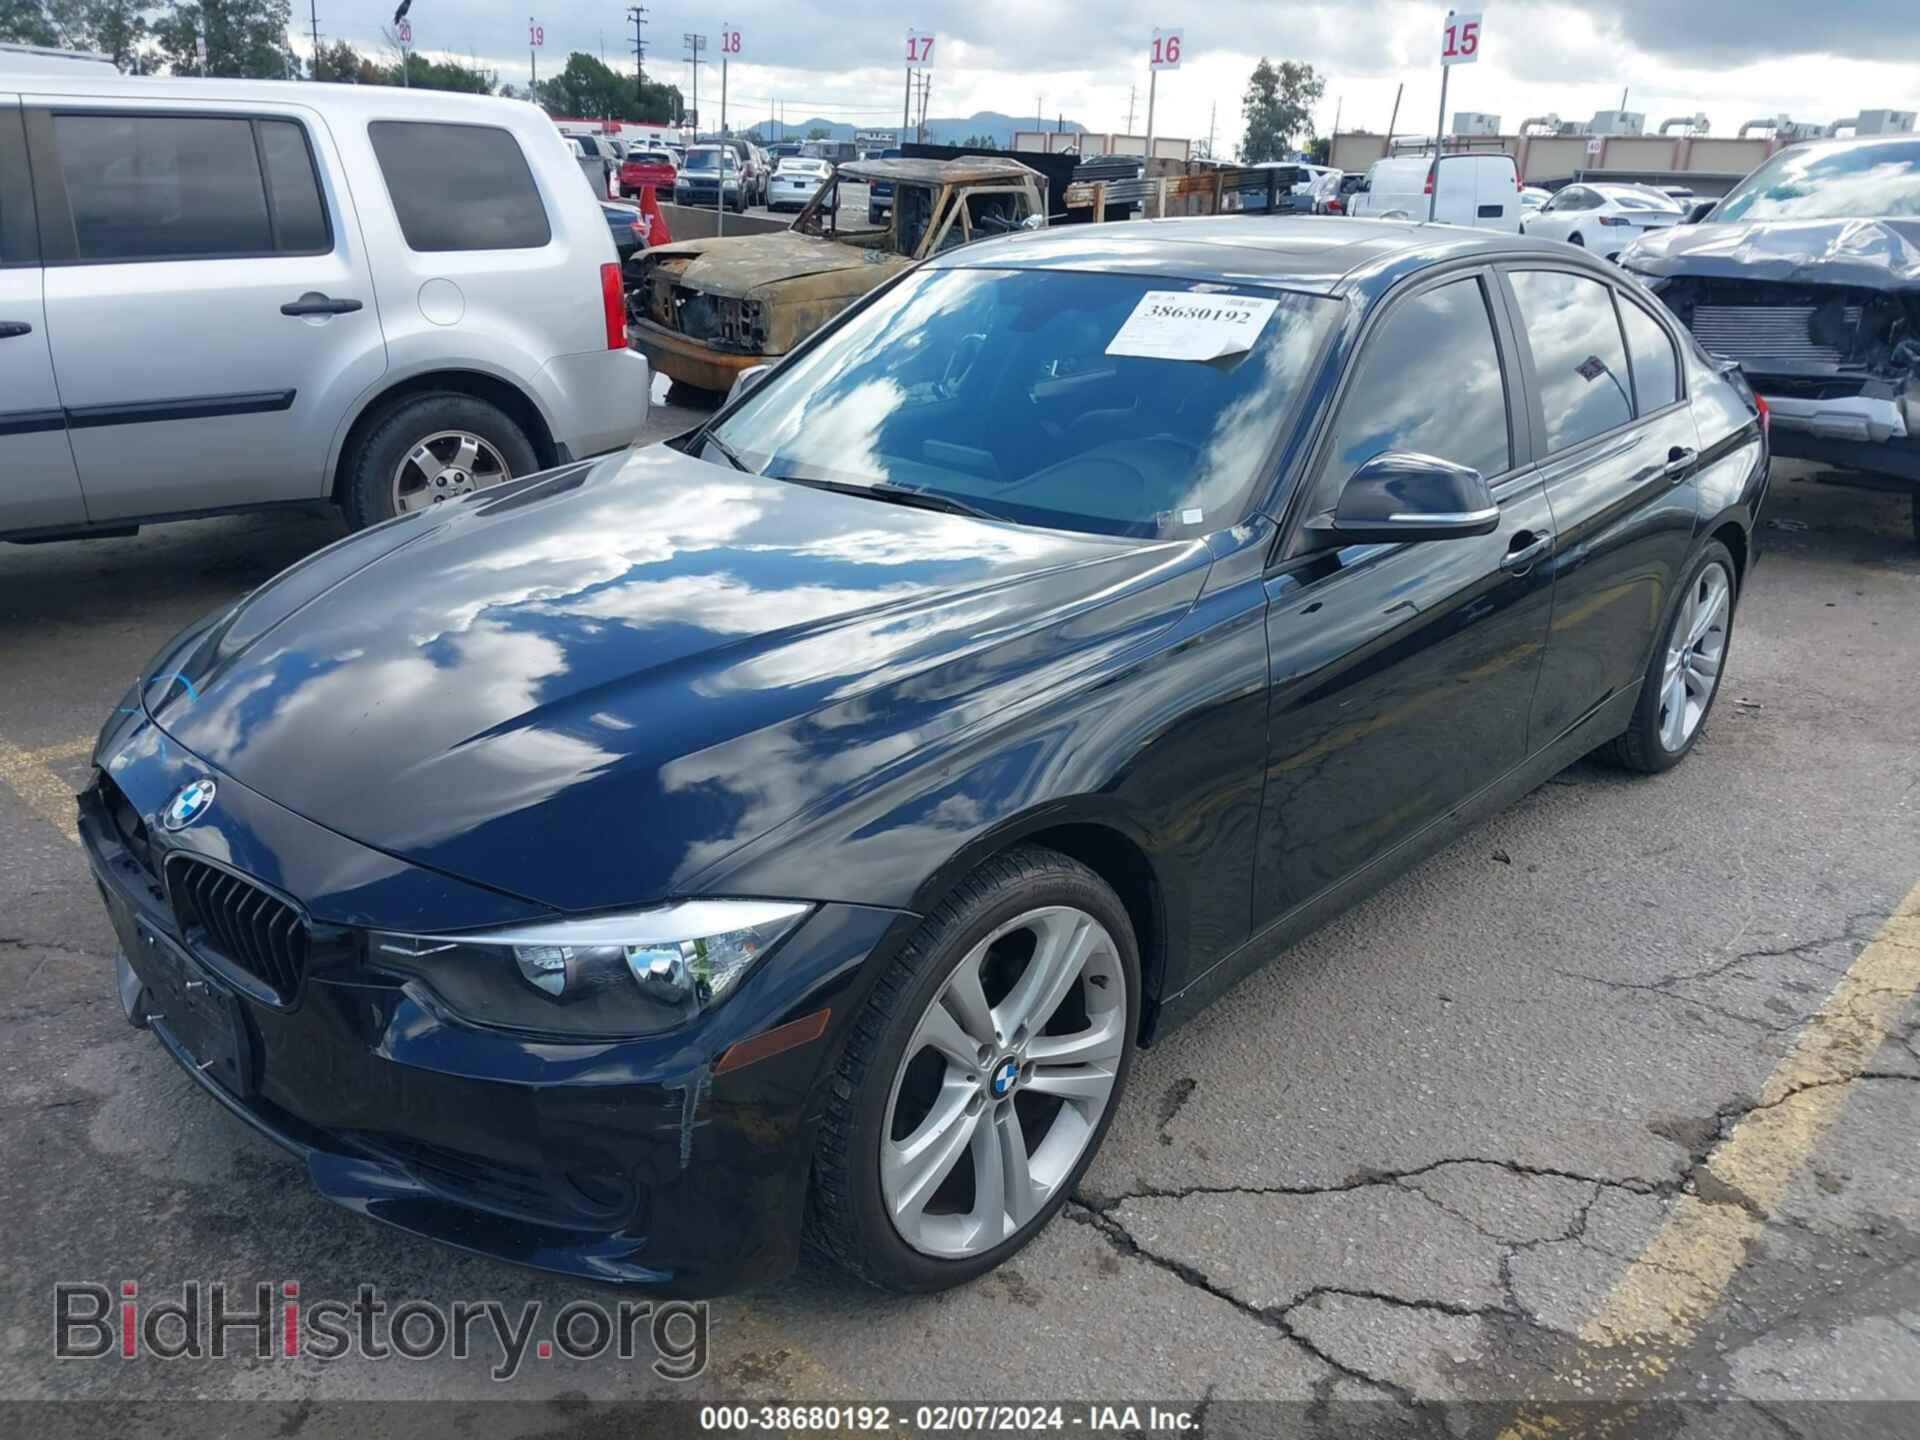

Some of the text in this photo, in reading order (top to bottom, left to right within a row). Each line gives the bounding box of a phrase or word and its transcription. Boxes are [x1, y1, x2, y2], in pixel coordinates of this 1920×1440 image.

[399, 24, 412, 42] 20
[529, 26, 544, 46] 19
[721, 31, 742, 53] 18
[1443, 22, 1479, 57] 15
[906, 37, 935, 62] 17
[1152, 36, 1180, 64] 16
[1144, 304, 1252, 325] 38680192
